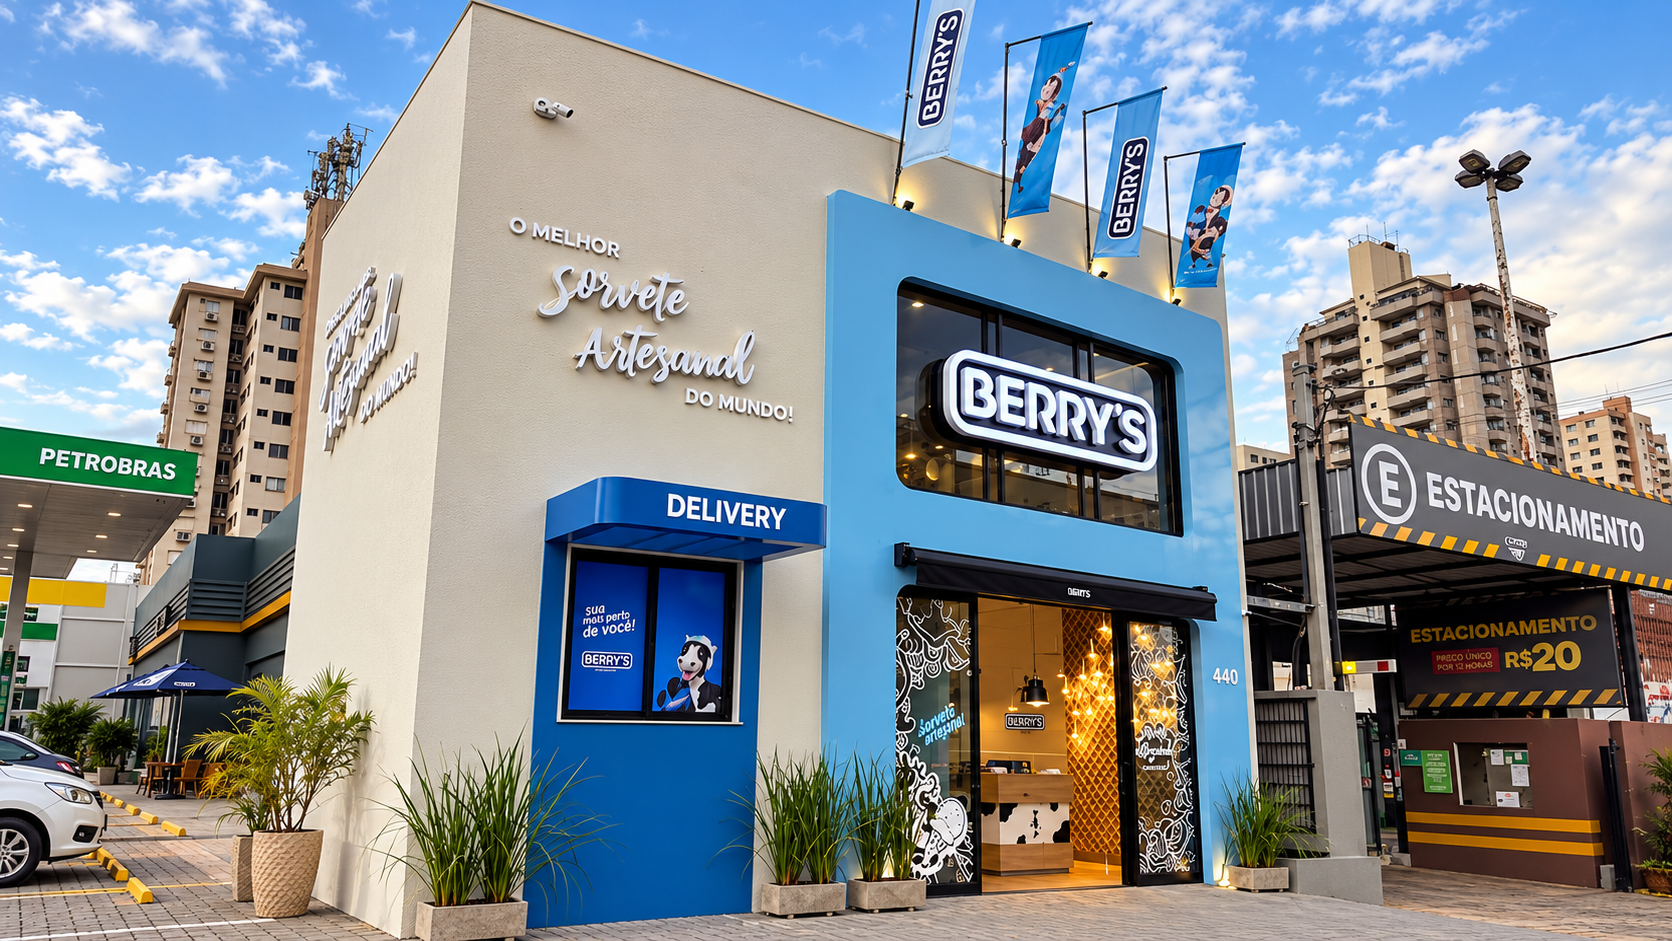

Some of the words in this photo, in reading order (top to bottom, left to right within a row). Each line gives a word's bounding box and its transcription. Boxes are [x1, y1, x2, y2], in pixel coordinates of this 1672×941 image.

[922, 15, 959, 121] BERRY'S
[1113, 143, 1144, 234] BERRY'S
[509, 217, 527, 234] O
[532, 222, 620, 258] MELHOR
[536, 264, 690, 323] Sorvete
[572, 324, 756, 386] Artesanal
[361, 393, 375, 424] DO
[374, 352, 419, 412] MUNDO!
[684, 387, 714, 407] DO
[718, 394, 794, 423] MUNDO!
[960, 366, 1148, 455] BERRY'S
[39, 447, 177, 480] PETROBRAS
[667, 493, 787, 530] DELIVERY
[1378, 460, 1402, 509] E
[1426, 471, 1645, 552] ESTACIONAMENTO
[585, 604, 605, 616] sua
[1410, 615, 1597, 643] ESTACIONAMENTO
[583, 625, 598, 638] de
[585, 654, 630, 666] BERRY'S
[1212, 667, 1239, 685] 440
